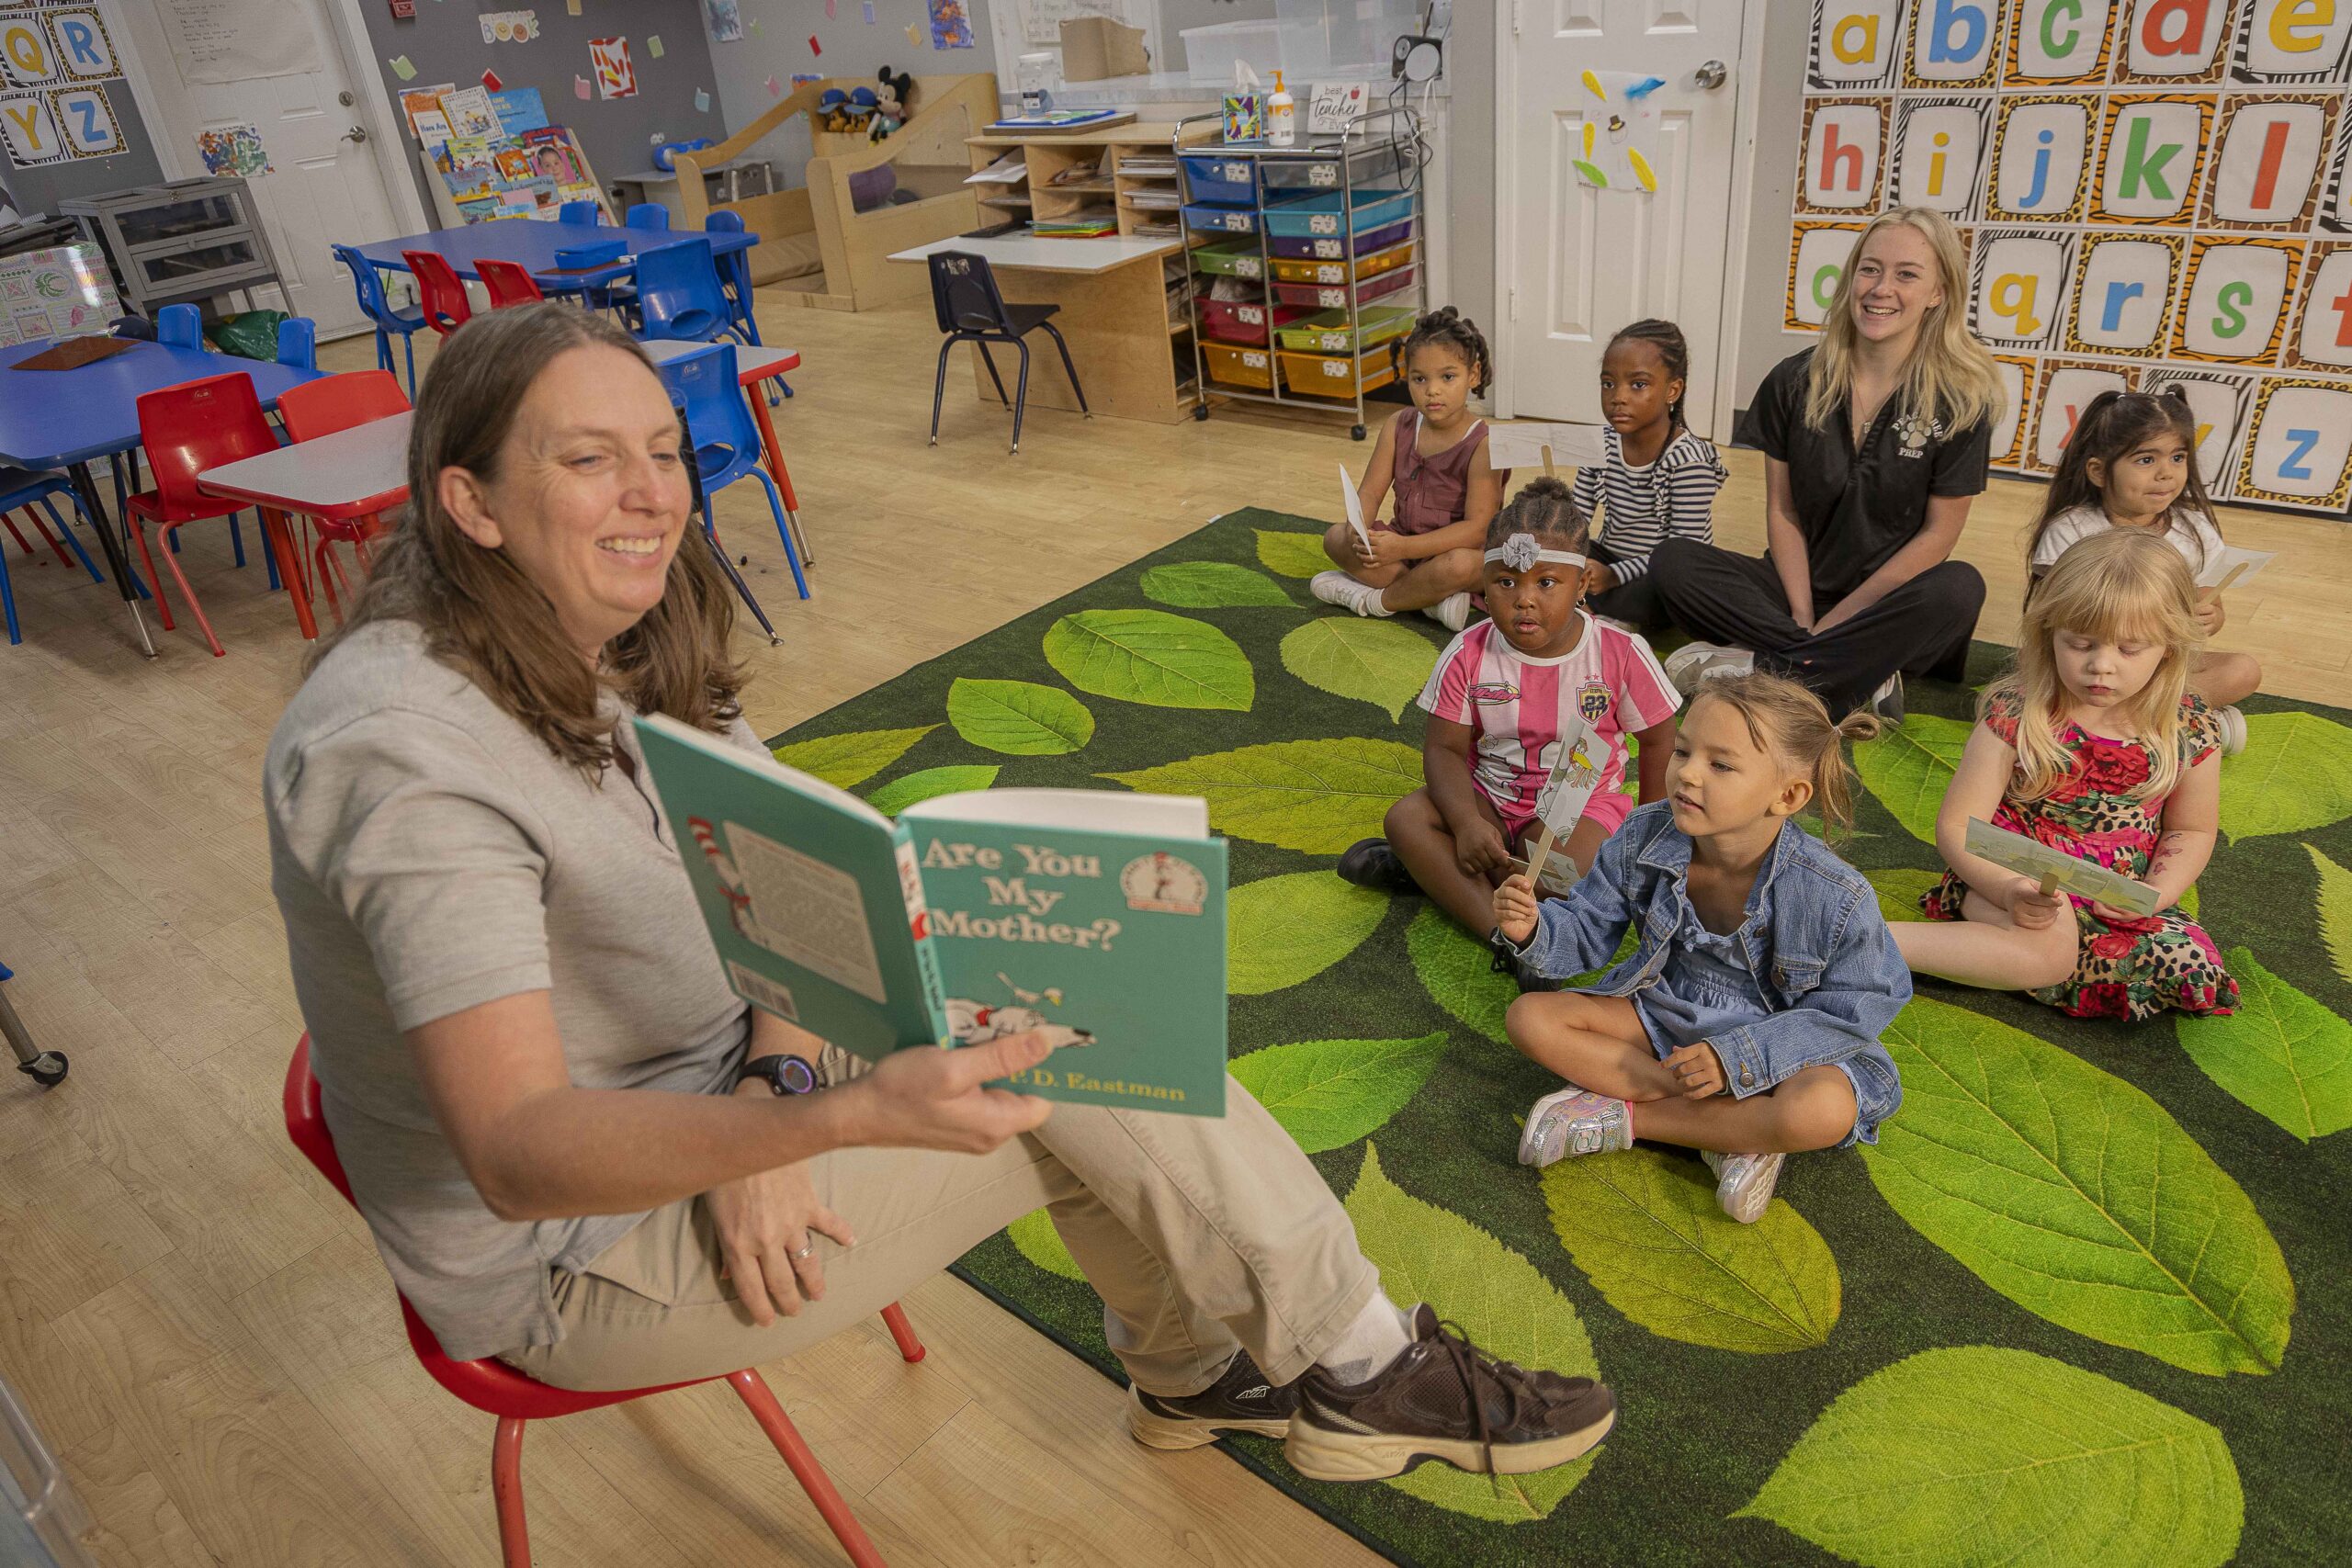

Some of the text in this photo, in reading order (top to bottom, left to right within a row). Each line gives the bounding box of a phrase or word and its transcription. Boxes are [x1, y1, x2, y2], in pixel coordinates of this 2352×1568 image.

[6, 21, 103, 76] Q R
[481, 19, 538, 43] BOOK
[1832, 13, 1880, 64] a
[1930, 0, 1985, 62] b
[2041, 0, 2081, 58] c
[2269, 0, 2335, 53] e
[1311, 94, 1359, 118] teacher
[1324, 86, 1342, 96] best
[6, 100, 107, 151] Y Z
[1820, 118, 2290, 210] h i j k l
[1990, 273, 2041, 336] q
[2102, 283, 2143, 331] r
[2212, 282, 2253, 339] s
[1897, 446, 1924, 459] PREP
[2279, 429, 2320, 479] z
[1584, 694, 1608, 713] 23
[920, 838, 1003, 870] Are
[1013, 843, 1102, 878] You
[981, 875, 1065, 916] My
[930, 908, 1121, 952] Mother?
[1032, 1068, 1060, 1088] D.
[1067, 1072, 1187, 1101] Eastman
